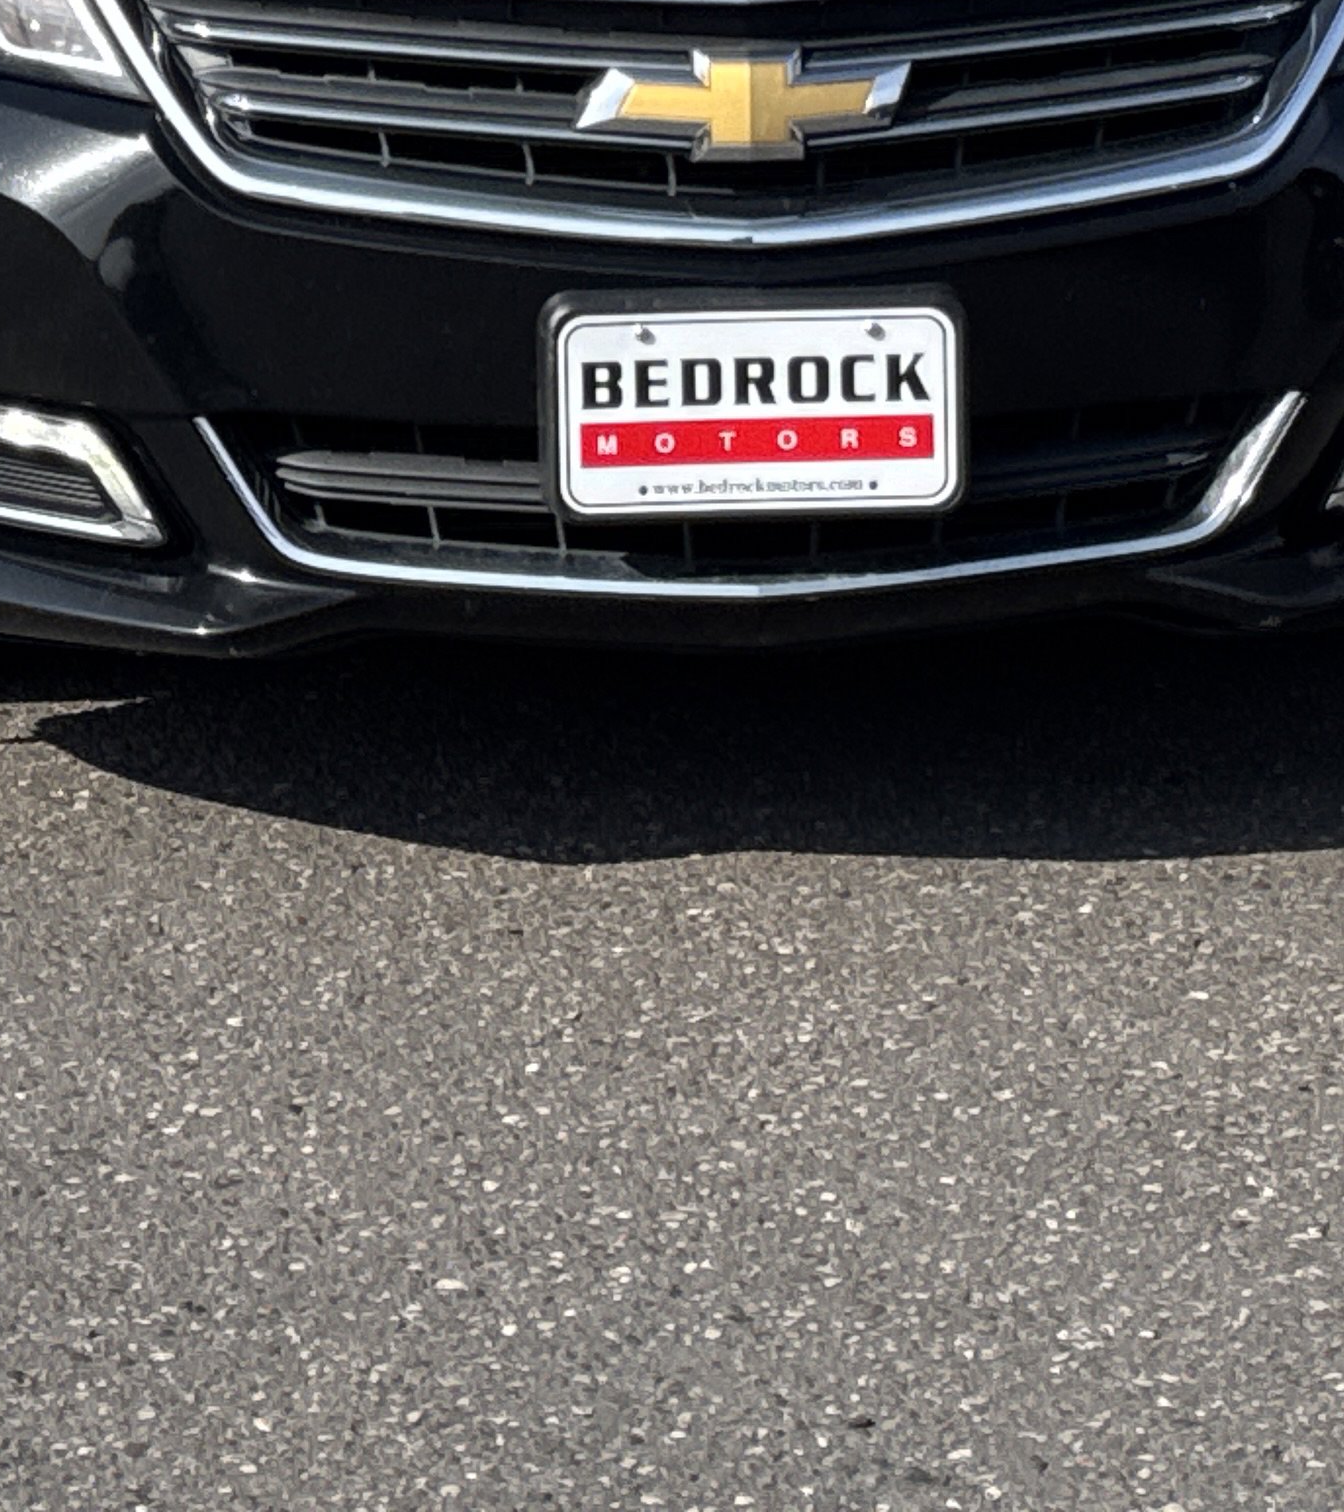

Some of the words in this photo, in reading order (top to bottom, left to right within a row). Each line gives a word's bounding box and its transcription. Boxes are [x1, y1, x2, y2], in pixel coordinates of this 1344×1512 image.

[580, 352, 931, 410] BEDROCK
[596, 426, 919, 456] MOTORS
[651, 476, 864, 495] www.bedrockmotors.com
